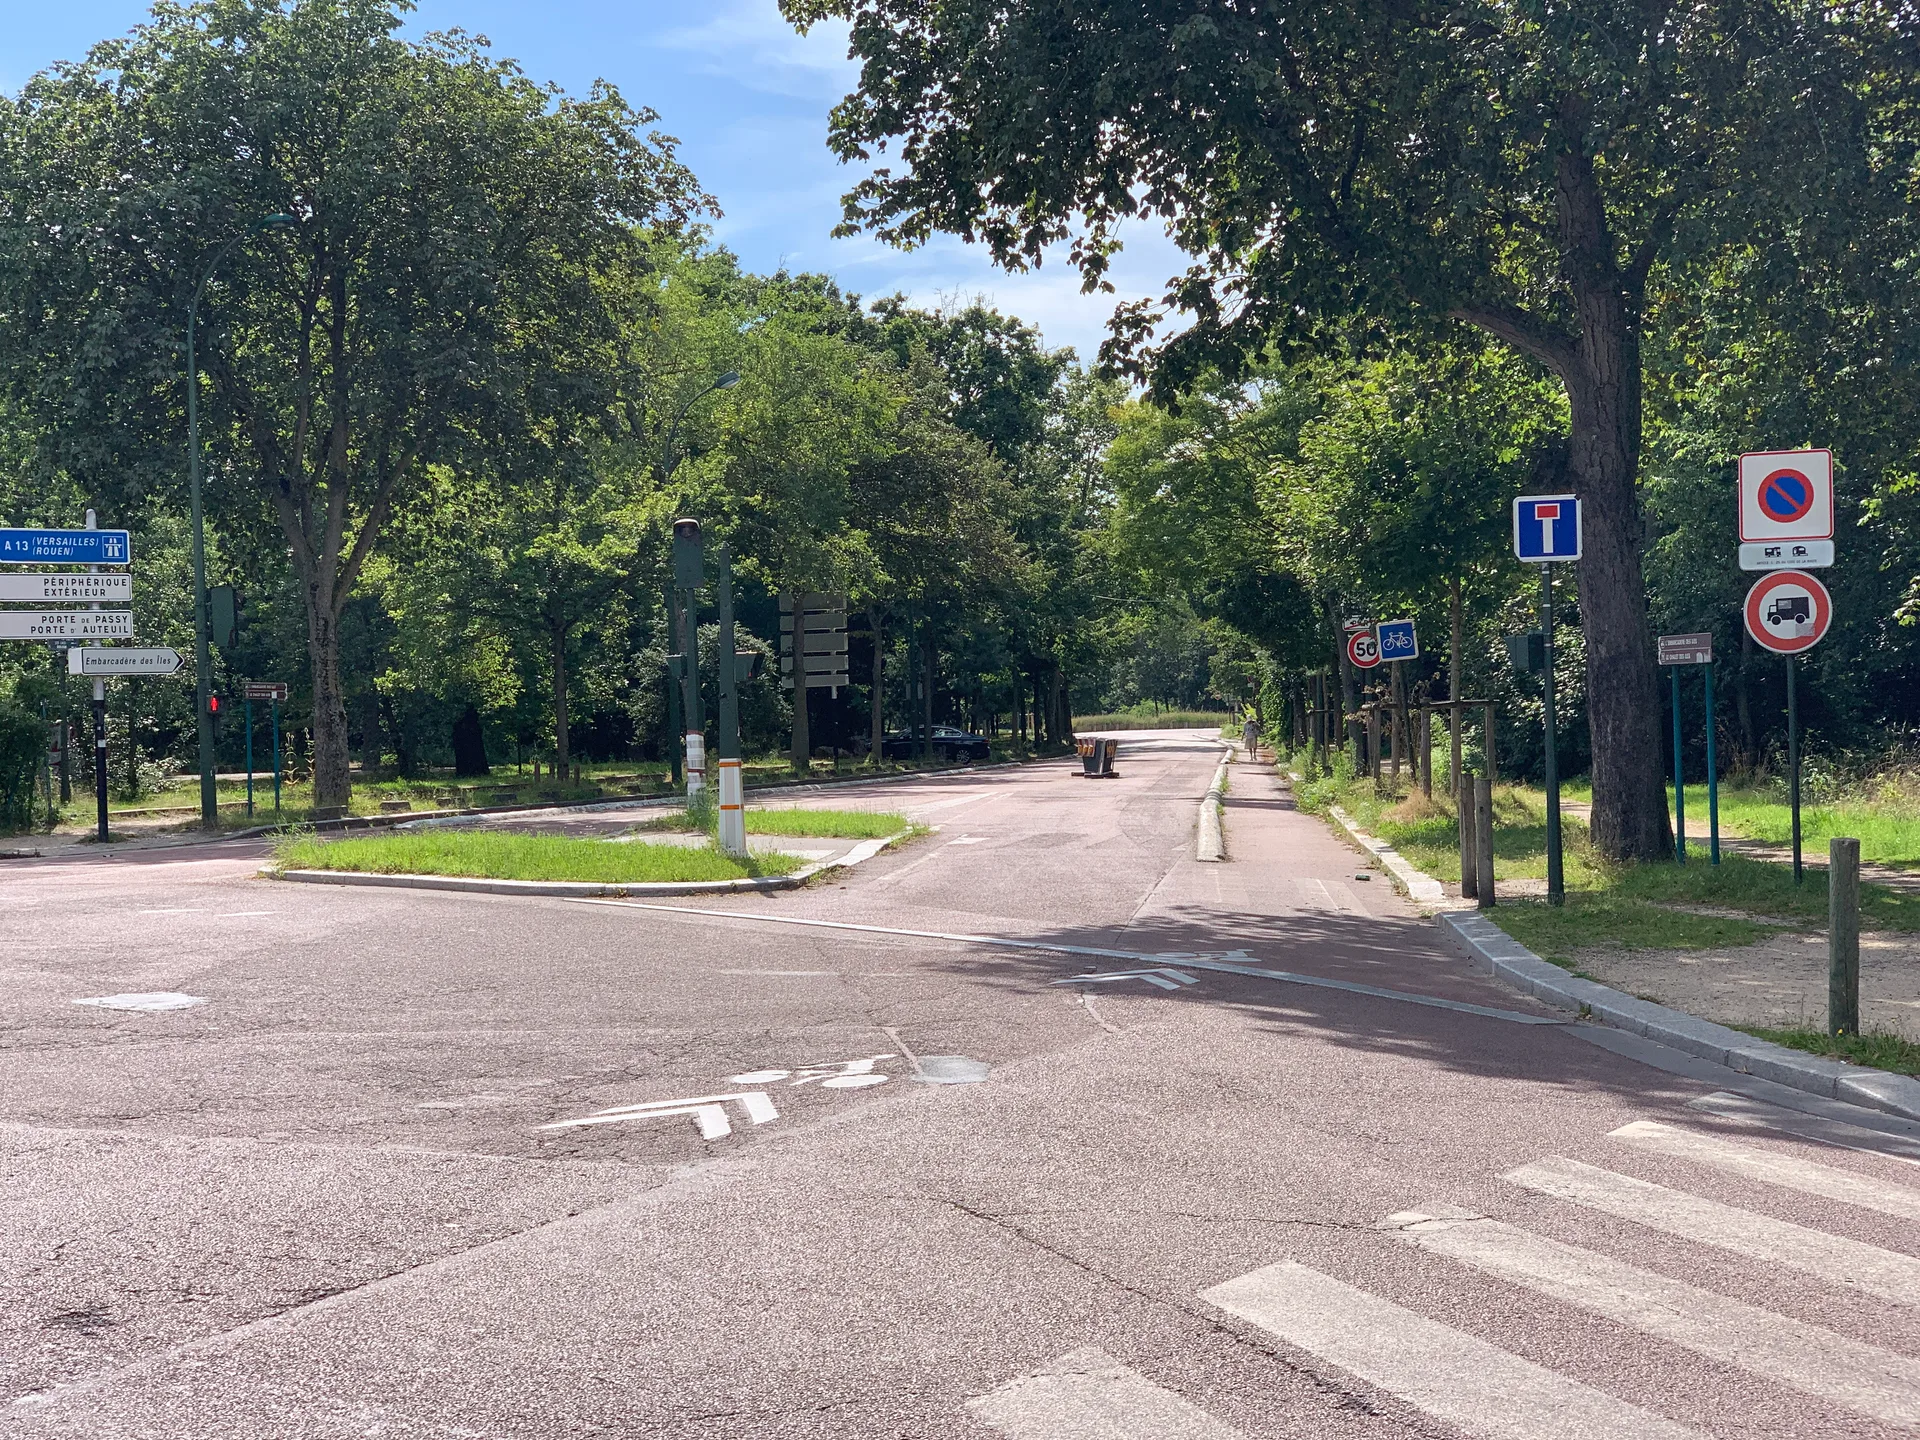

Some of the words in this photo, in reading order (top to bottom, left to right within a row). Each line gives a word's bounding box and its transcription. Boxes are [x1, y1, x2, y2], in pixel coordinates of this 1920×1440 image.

[4, 540, 12, 551] A
[15, 540, 29, 551] 13
[32, 536, 99, 547] (VERSAILLES)
[32, 546, 74, 556] (ROUEN)
[43, 577, 127, 587] PÉRIPHÉRIQUE
[44, 587, 106, 597] EXTÉRIEUR
[41, 615, 76, 624] PORTE
[95, 615, 128, 624] PASSY
[30, 625, 65, 634] PORTE
[83, 625, 129, 634] AUTEUIL
[1356, 642, 1377, 657] 50
[85, 657, 137, 665] Embarcadère
[140, 657, 153, 665] des
[156, 654, 171, 665] Îles
